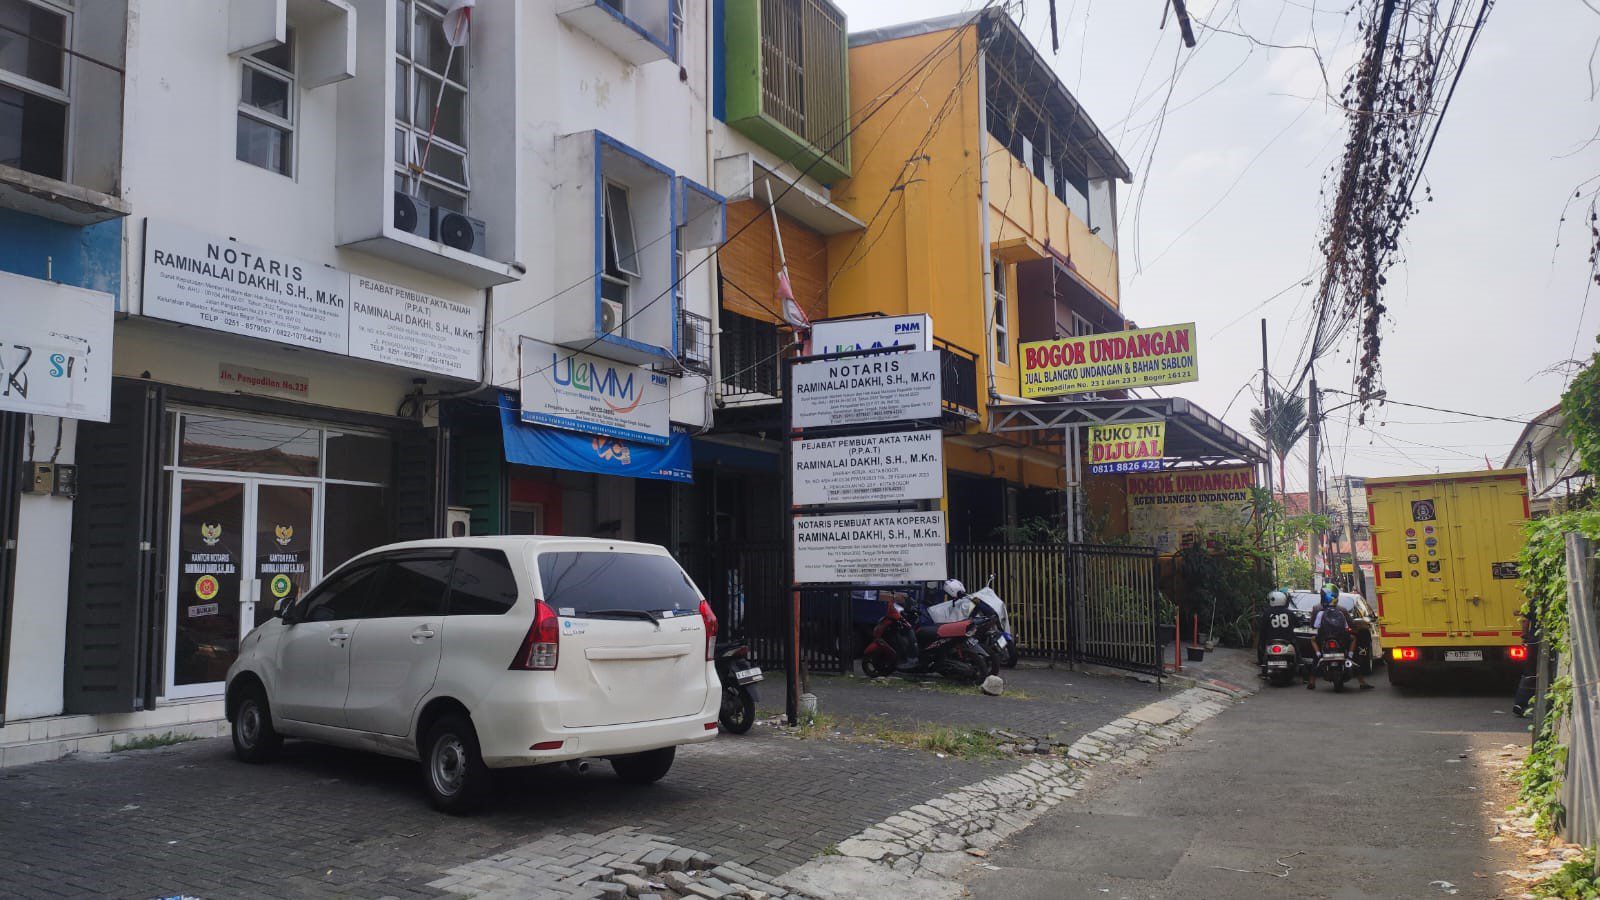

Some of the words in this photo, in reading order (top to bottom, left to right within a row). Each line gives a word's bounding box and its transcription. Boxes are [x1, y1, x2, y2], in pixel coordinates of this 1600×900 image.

[207, 243, 302, 281] NOTARIS
[154, 249, 234, 282] RAMINALAI
[238, 270, 283, 296] DAKHI,
[286, 282, 313, 303] S.H.,
[316, 290, 344, 309] M.Kn
[359, 279, 394, 296] PEJABAT
[395, 289, 429, 304] PEMBUAT
[430, 298, 448, 309] AKTA
[449, 303, 471, 315] TANAH
[353, 301, 403, 323] RAMINALAI
[894, 322, 920, 332] PNM
[1025, 341, 1086, 370] BOGOR
[1088, 328, 1190, 363] UNDANGAN
[829, 361, 900, 378] NOTARIS
[1025, 372, 1042, 385] JUAL
[1043, 369, 1079, 383] BLANGKO
[1080, 364, 1123, 380] UNDANGAN
[1124, 363, 1131, 373] &
[1132, 360, 1160, 373] BAHAN
[1161, 355, 1193, 370] SABLON
[797, 379, 849, 393] RAMINALAI
[851, 377, 884, 388] DAKHI,
[886, 374, 908, 385] S.H.,
[910, 371, 935, 383] M.Kn
[1037, 383, 1076, 394] Pengadilan
[1077, 380, 1089, 389] No.
[1091, 379, 1100, 387] 23
[1143, 375, 1166, 383] Bogor
[1167, 370, 1191, 379] 16121
[801, 440, 836, 450] PEJABAT
[838, 437, 876, 448] PEMBUAT
[878, 435, 900, 444] AKTA
[903, 433, 932, 443] TANAH
[1093, 427, 1133, 442] RUKO
[1136, 424, 1161, 438] INI
[1091, 439, 1161, 462] DIJUAL
[796, 458, 848, 471] RAMINALAI
[851, 457, 883, 467] DAKHI,
[885, 455, 908, 465] S.H.,
[910, 453, 937, 463] M.Kn.
[1092, 465, 1114, 474] 0811
[1116, 462, 1140, 471] 8826
[1141, 460, 1160, 469] 422
[1176, 471, 1250, 492] UNDANGAN
[1134, 496, 1155, 506] AGEN
[1157, 494, 1197, 504] BLANGKO
[1199, 492, 1246, 502] UNDANGAN
[798, 520, 832, 530] NOTARIS
[833, 518, 871, 528] PEMBUAT
[873, 517, 895, 526] AKTA
[896, 515, 940, 525] KOPERASI
[798, 531, 851, 543] RAMINALAI
[852, 530, 886, 541] DAKHI,
[888, 529, 911, 540] S.H.,
[913, 528, 941, 539] M.Kn.
